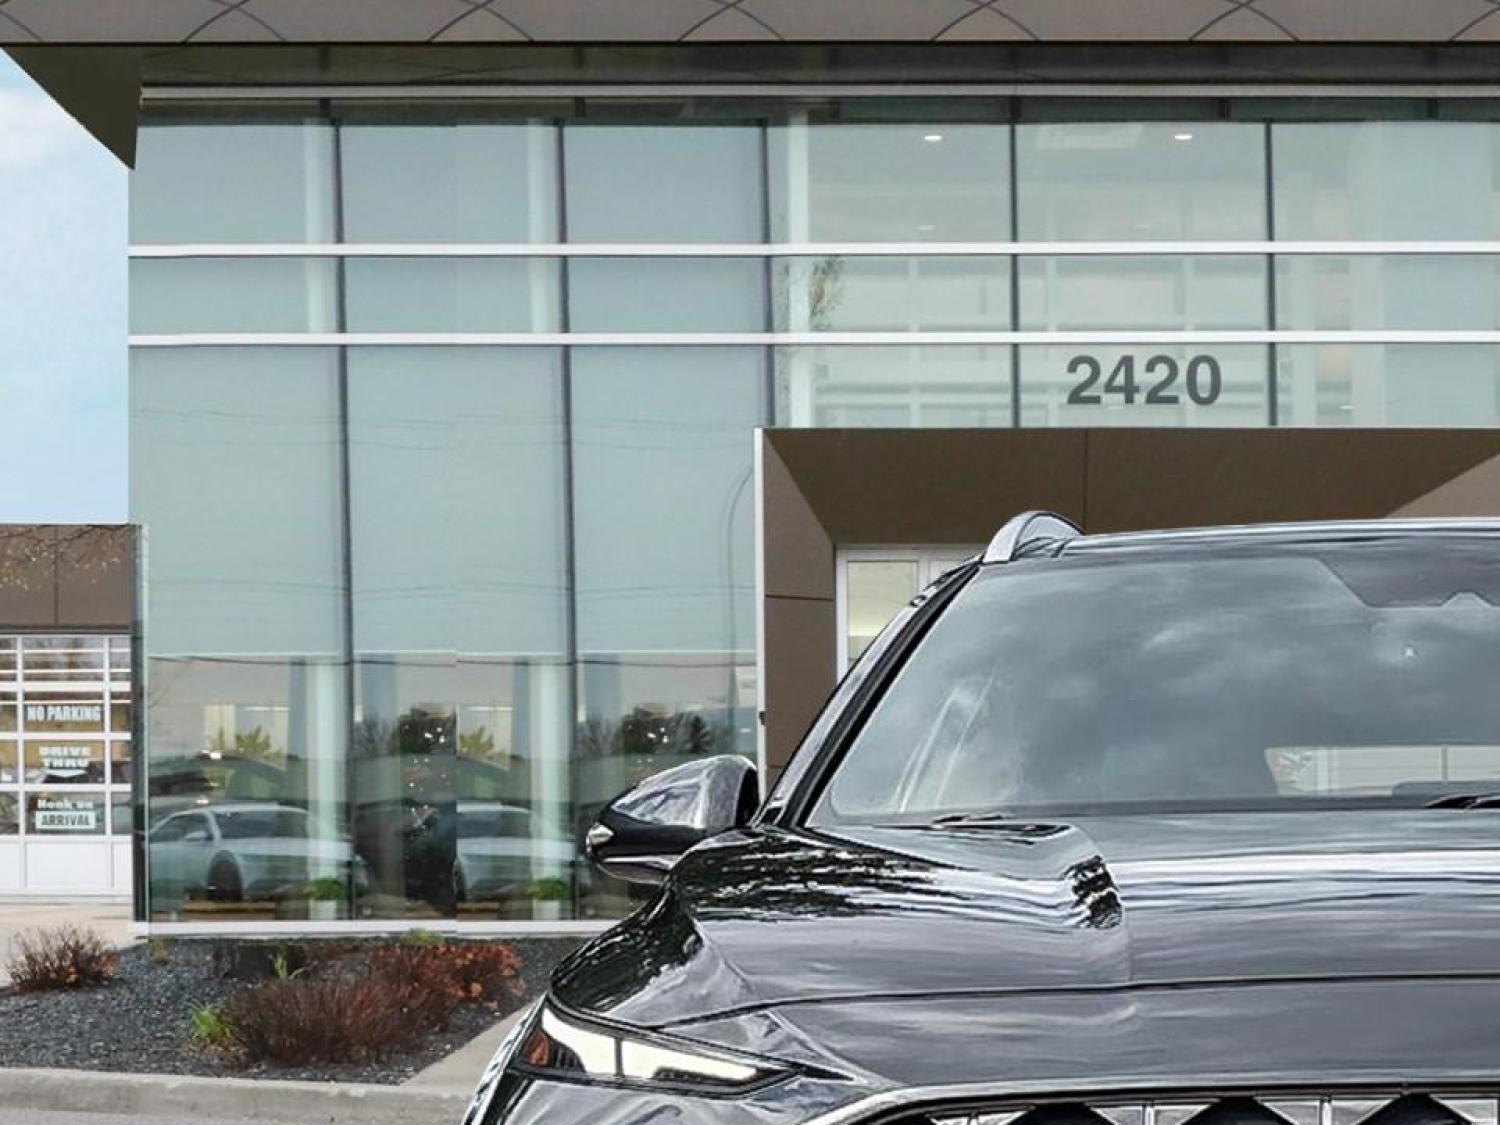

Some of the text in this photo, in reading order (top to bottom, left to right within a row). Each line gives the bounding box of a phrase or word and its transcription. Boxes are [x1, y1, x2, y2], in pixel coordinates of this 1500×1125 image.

[1066, 354, 1222, 406] 2420
[27, 706, 101, 721] NO PARKING
[41, 814, 91, 826] ARRIVAL
